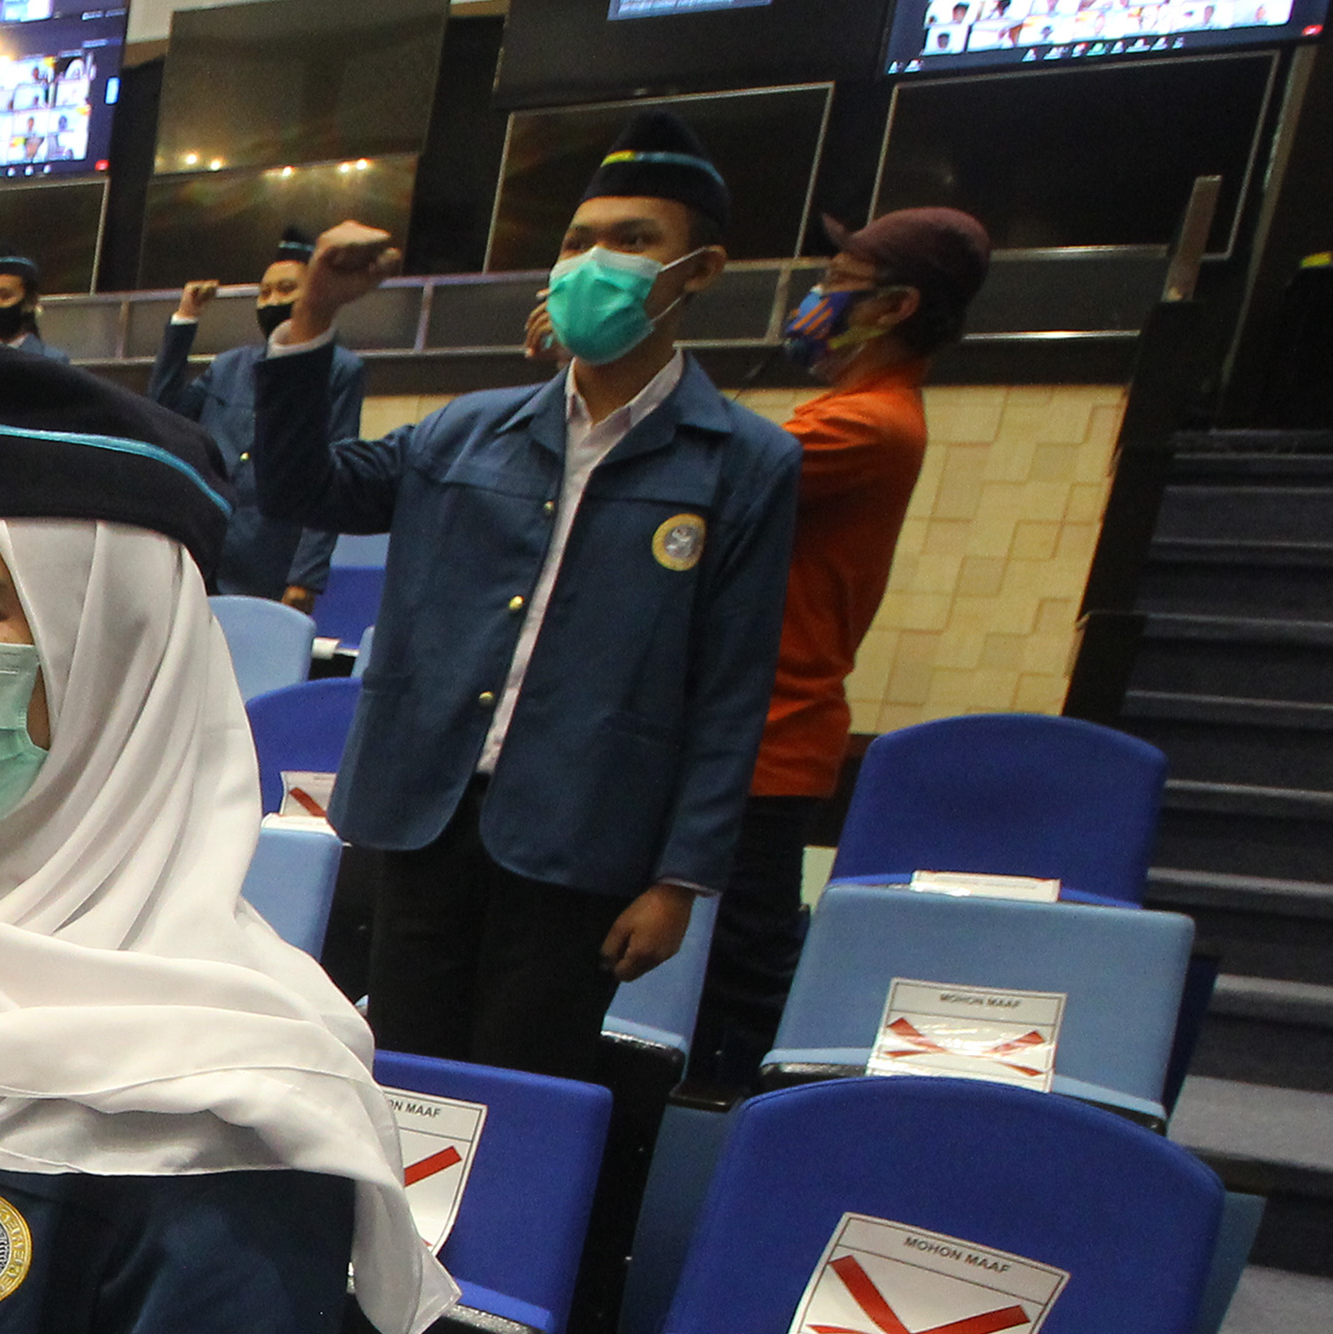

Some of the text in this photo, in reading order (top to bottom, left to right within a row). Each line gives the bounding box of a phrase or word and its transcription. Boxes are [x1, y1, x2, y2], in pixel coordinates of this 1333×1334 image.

[405, 1103, 441, 1118] MAAF
[903, 1236, 1011, 1274] MOHON MAAF
